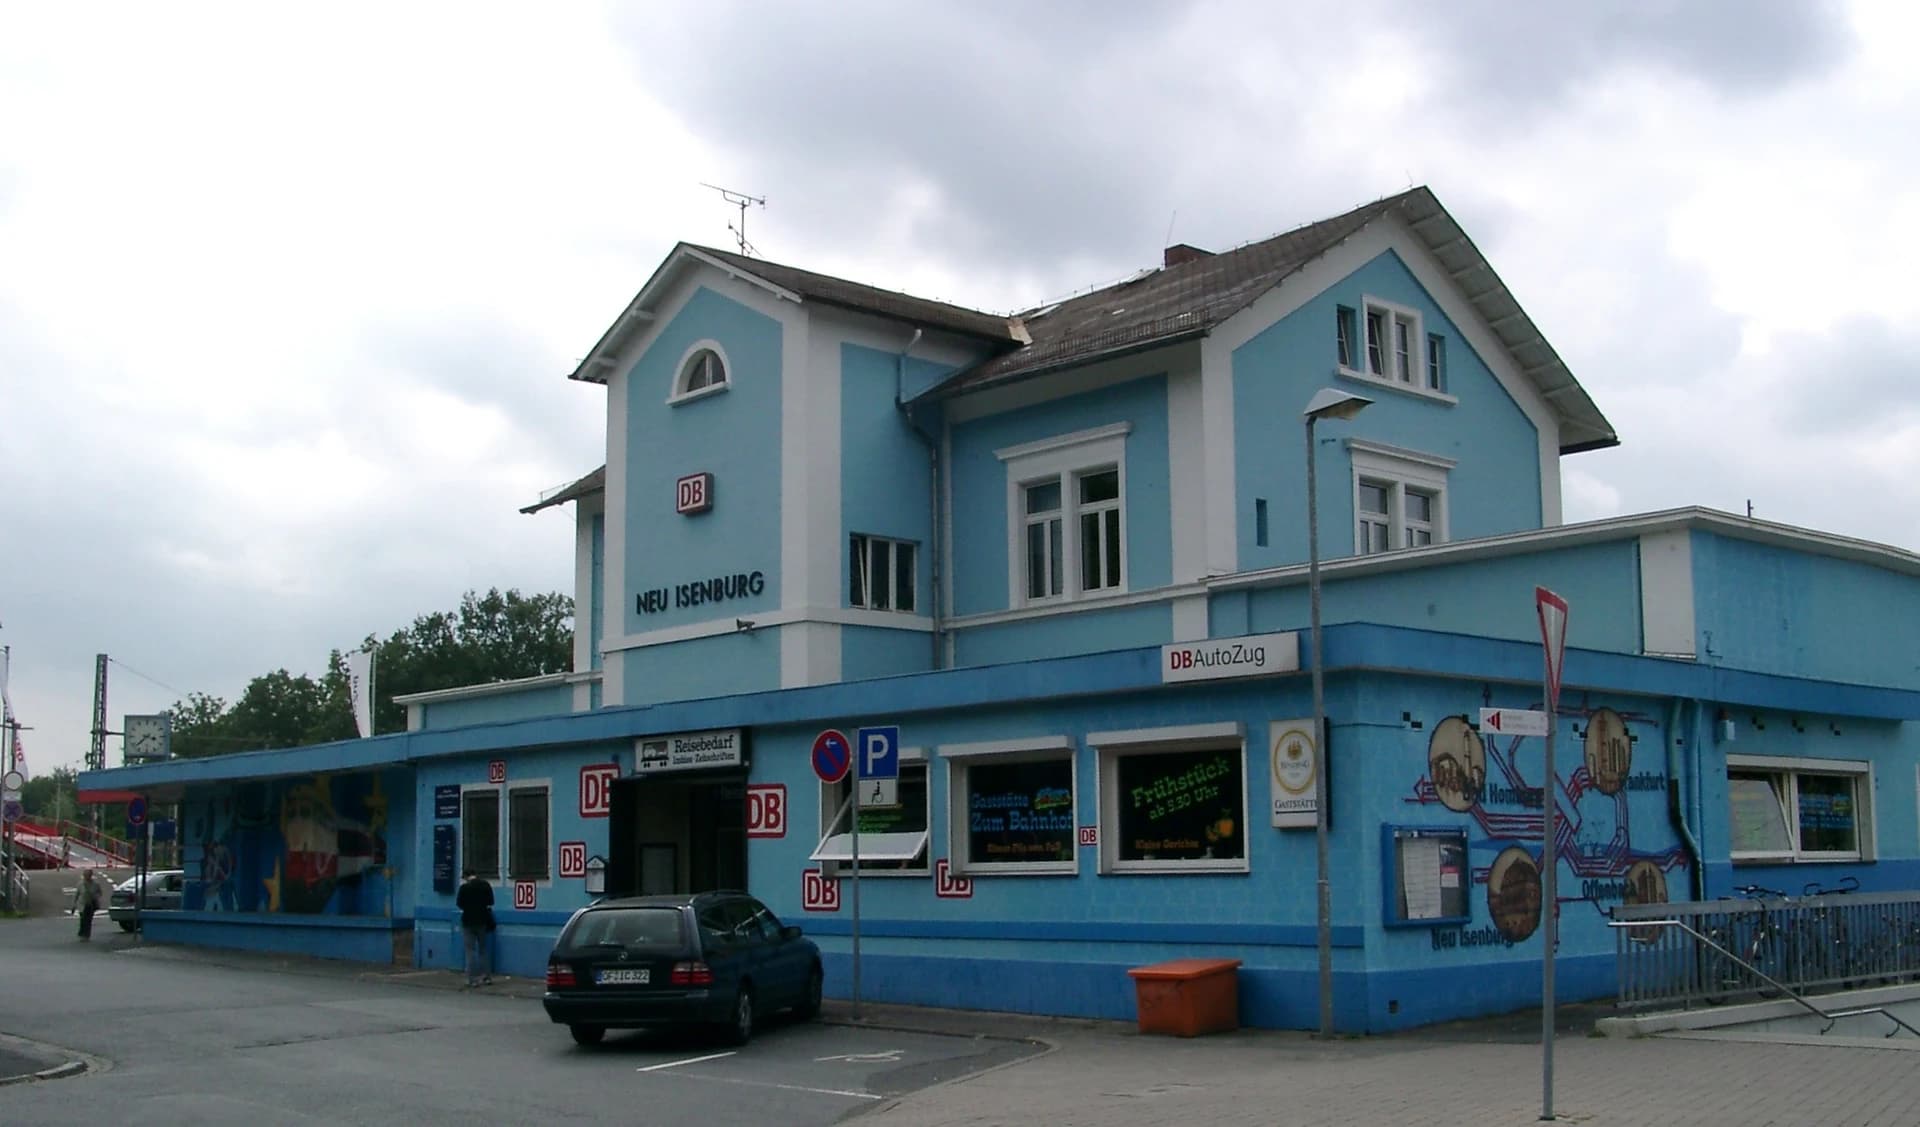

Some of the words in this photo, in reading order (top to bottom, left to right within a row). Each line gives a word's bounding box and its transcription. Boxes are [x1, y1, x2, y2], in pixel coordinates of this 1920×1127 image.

[680, 480, 703, 508] DB
[636, 588, 668, 615] NEU
[675, 571, 764, 609] ISENBURG
[674, 734, 735, 754] Reisebedarf
[867, 734, 889, 775] P
[491, 763, 505, 780] DB
[1132, 757, 1229, 808] Frühstück
[747, 792, 781, 831] DB
[1149, 804, 1165, 820] ab
[1194, 786, 1218, 803] Uhr
[971, 812, 1005, 832] Zum
[1081, 829, 1097, 843] DB
[562, 847, 583, 873] DB
[517, 884, 534, 906] DB
[807, 875, 836, 905] DB
